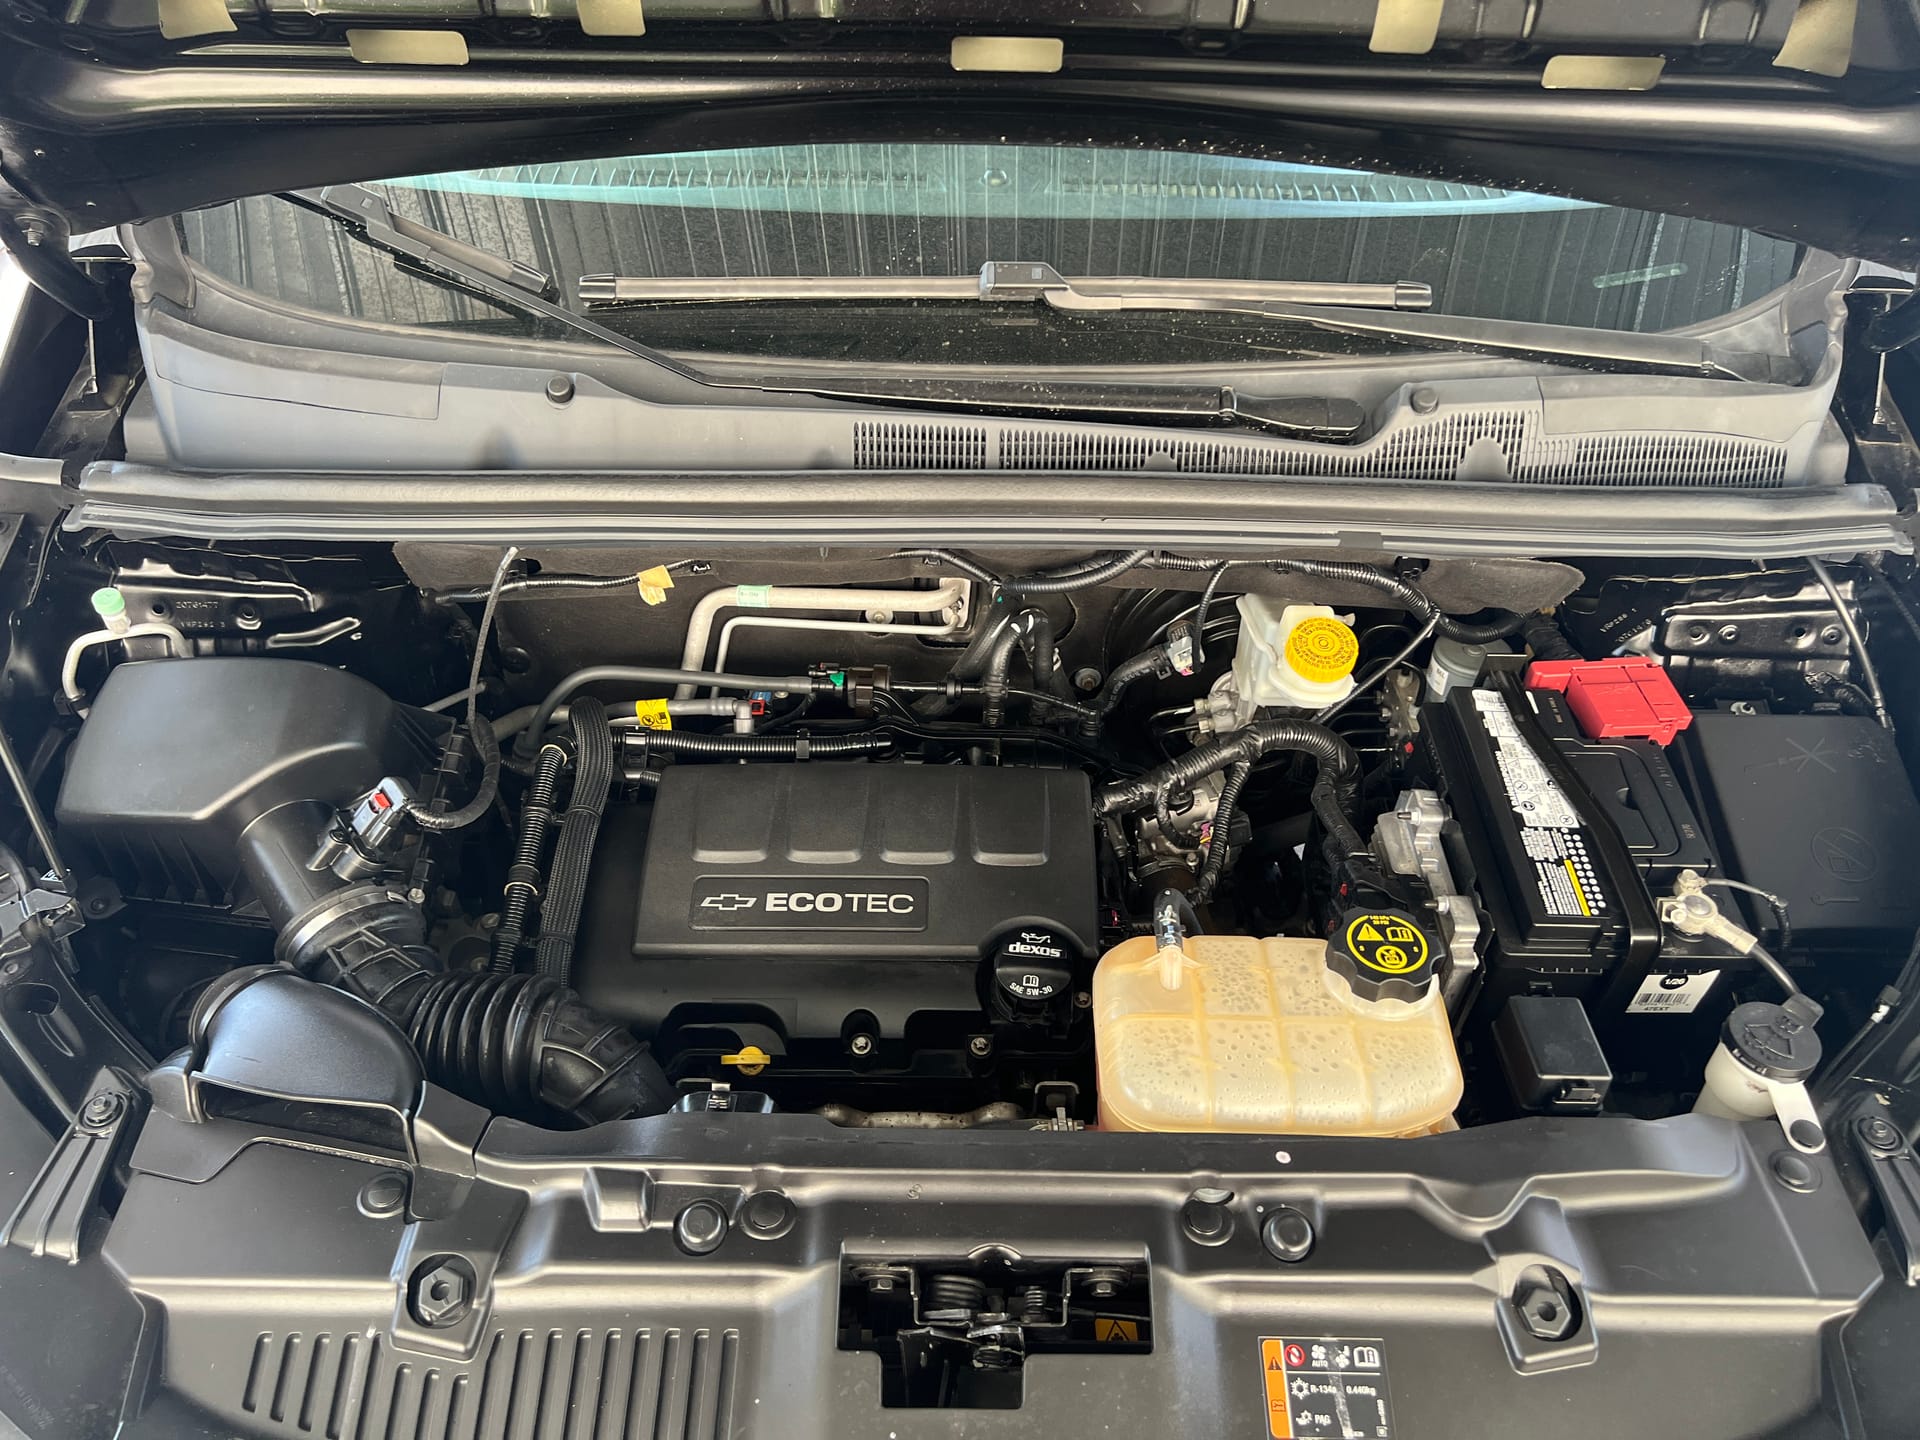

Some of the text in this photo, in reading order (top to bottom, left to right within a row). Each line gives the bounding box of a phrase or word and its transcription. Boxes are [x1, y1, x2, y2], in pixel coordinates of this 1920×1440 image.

[765, 892, 914, 914] ECOTEC
[1008, 941, 1063, 957] dexos
[1009, 982, 1053, 996] SAE 5W-30
[1311, 1359, 1329, 1367] AUTO
